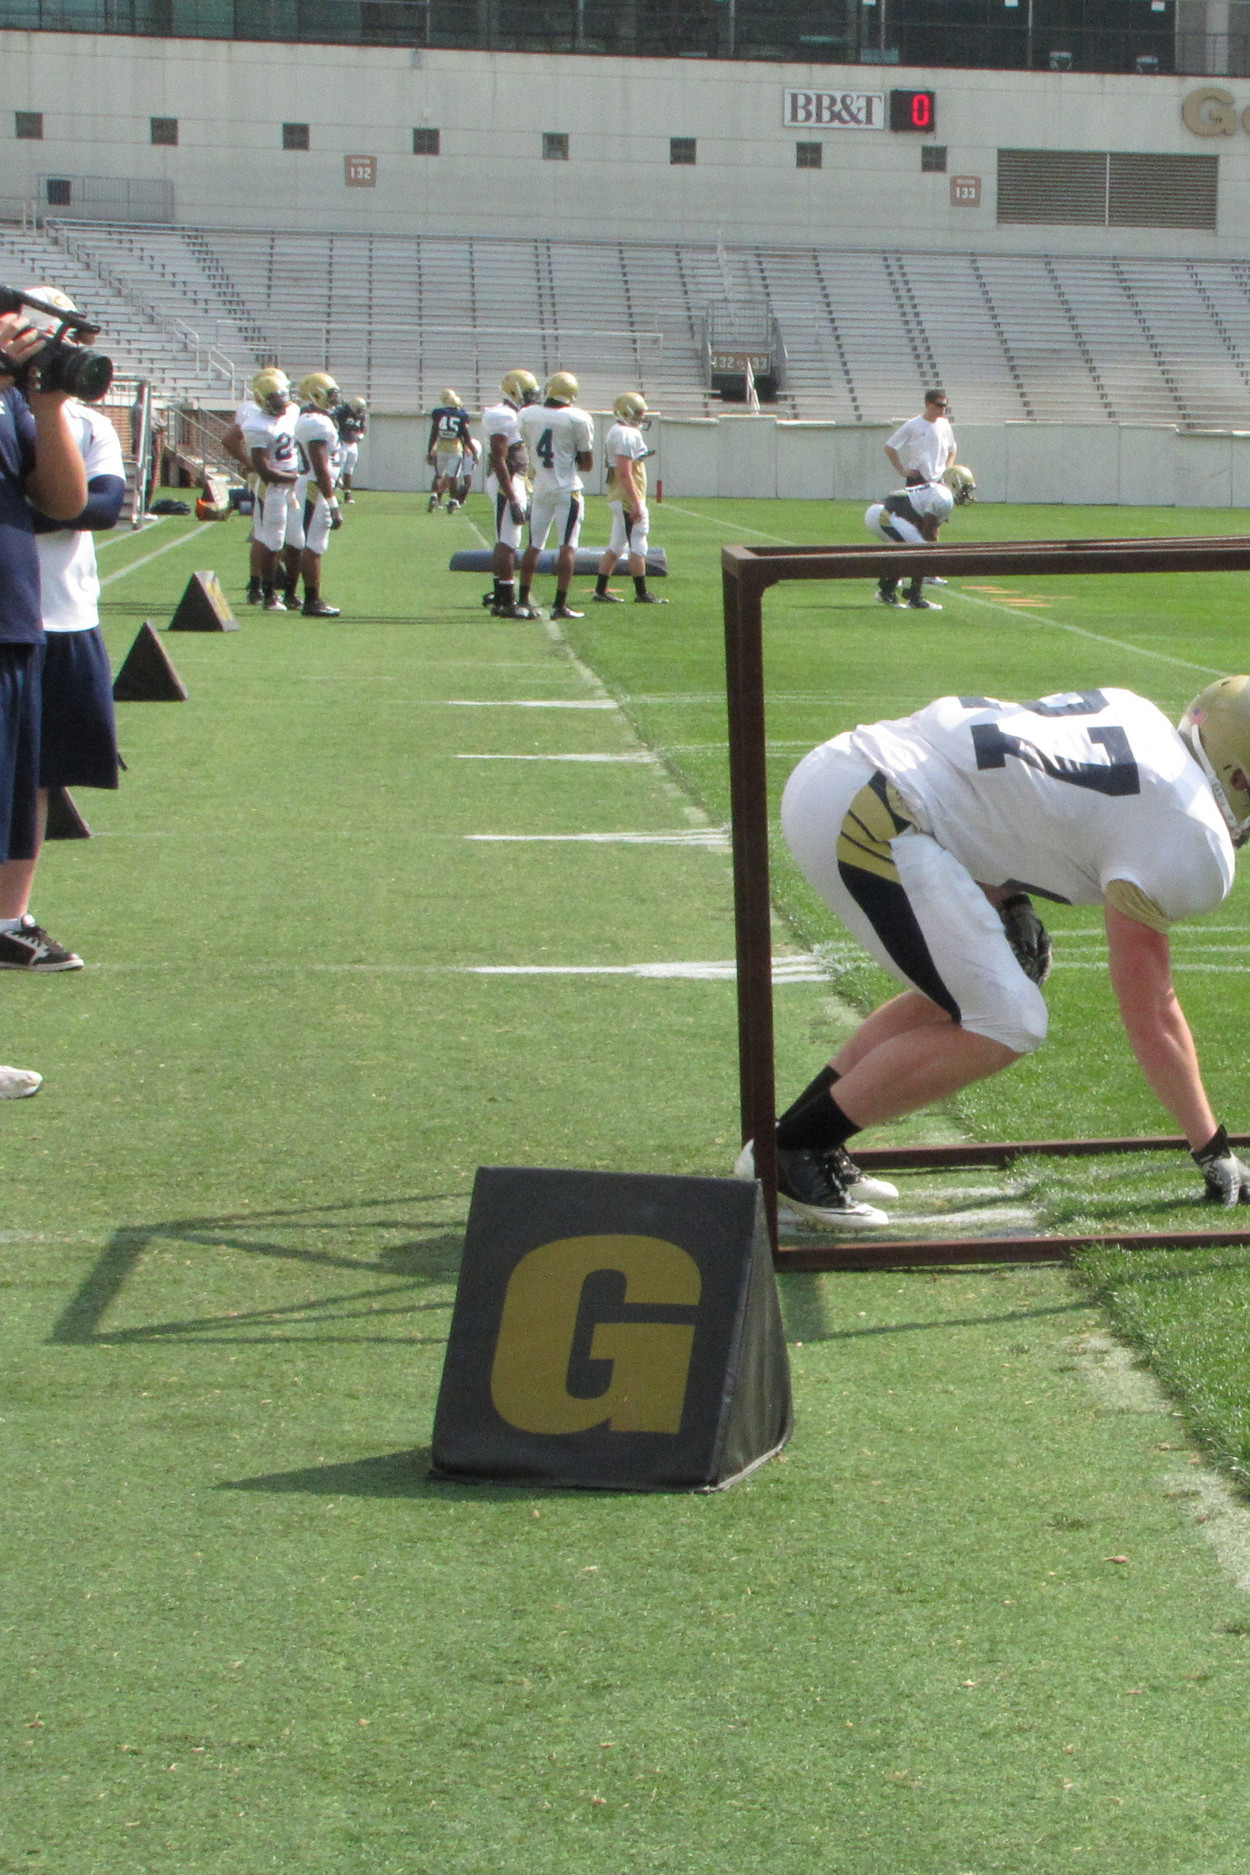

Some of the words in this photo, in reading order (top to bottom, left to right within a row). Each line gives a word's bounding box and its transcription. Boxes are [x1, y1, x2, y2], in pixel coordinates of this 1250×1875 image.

[790, 92, 882, 126] BB&T
[912, 94, 930, 126] 0
[350, 166, 371, 179] 132
[956, 187, 976, 199] 133
[535, 428, 555, 469] 4
[489, 1234, 704, 1436] G
